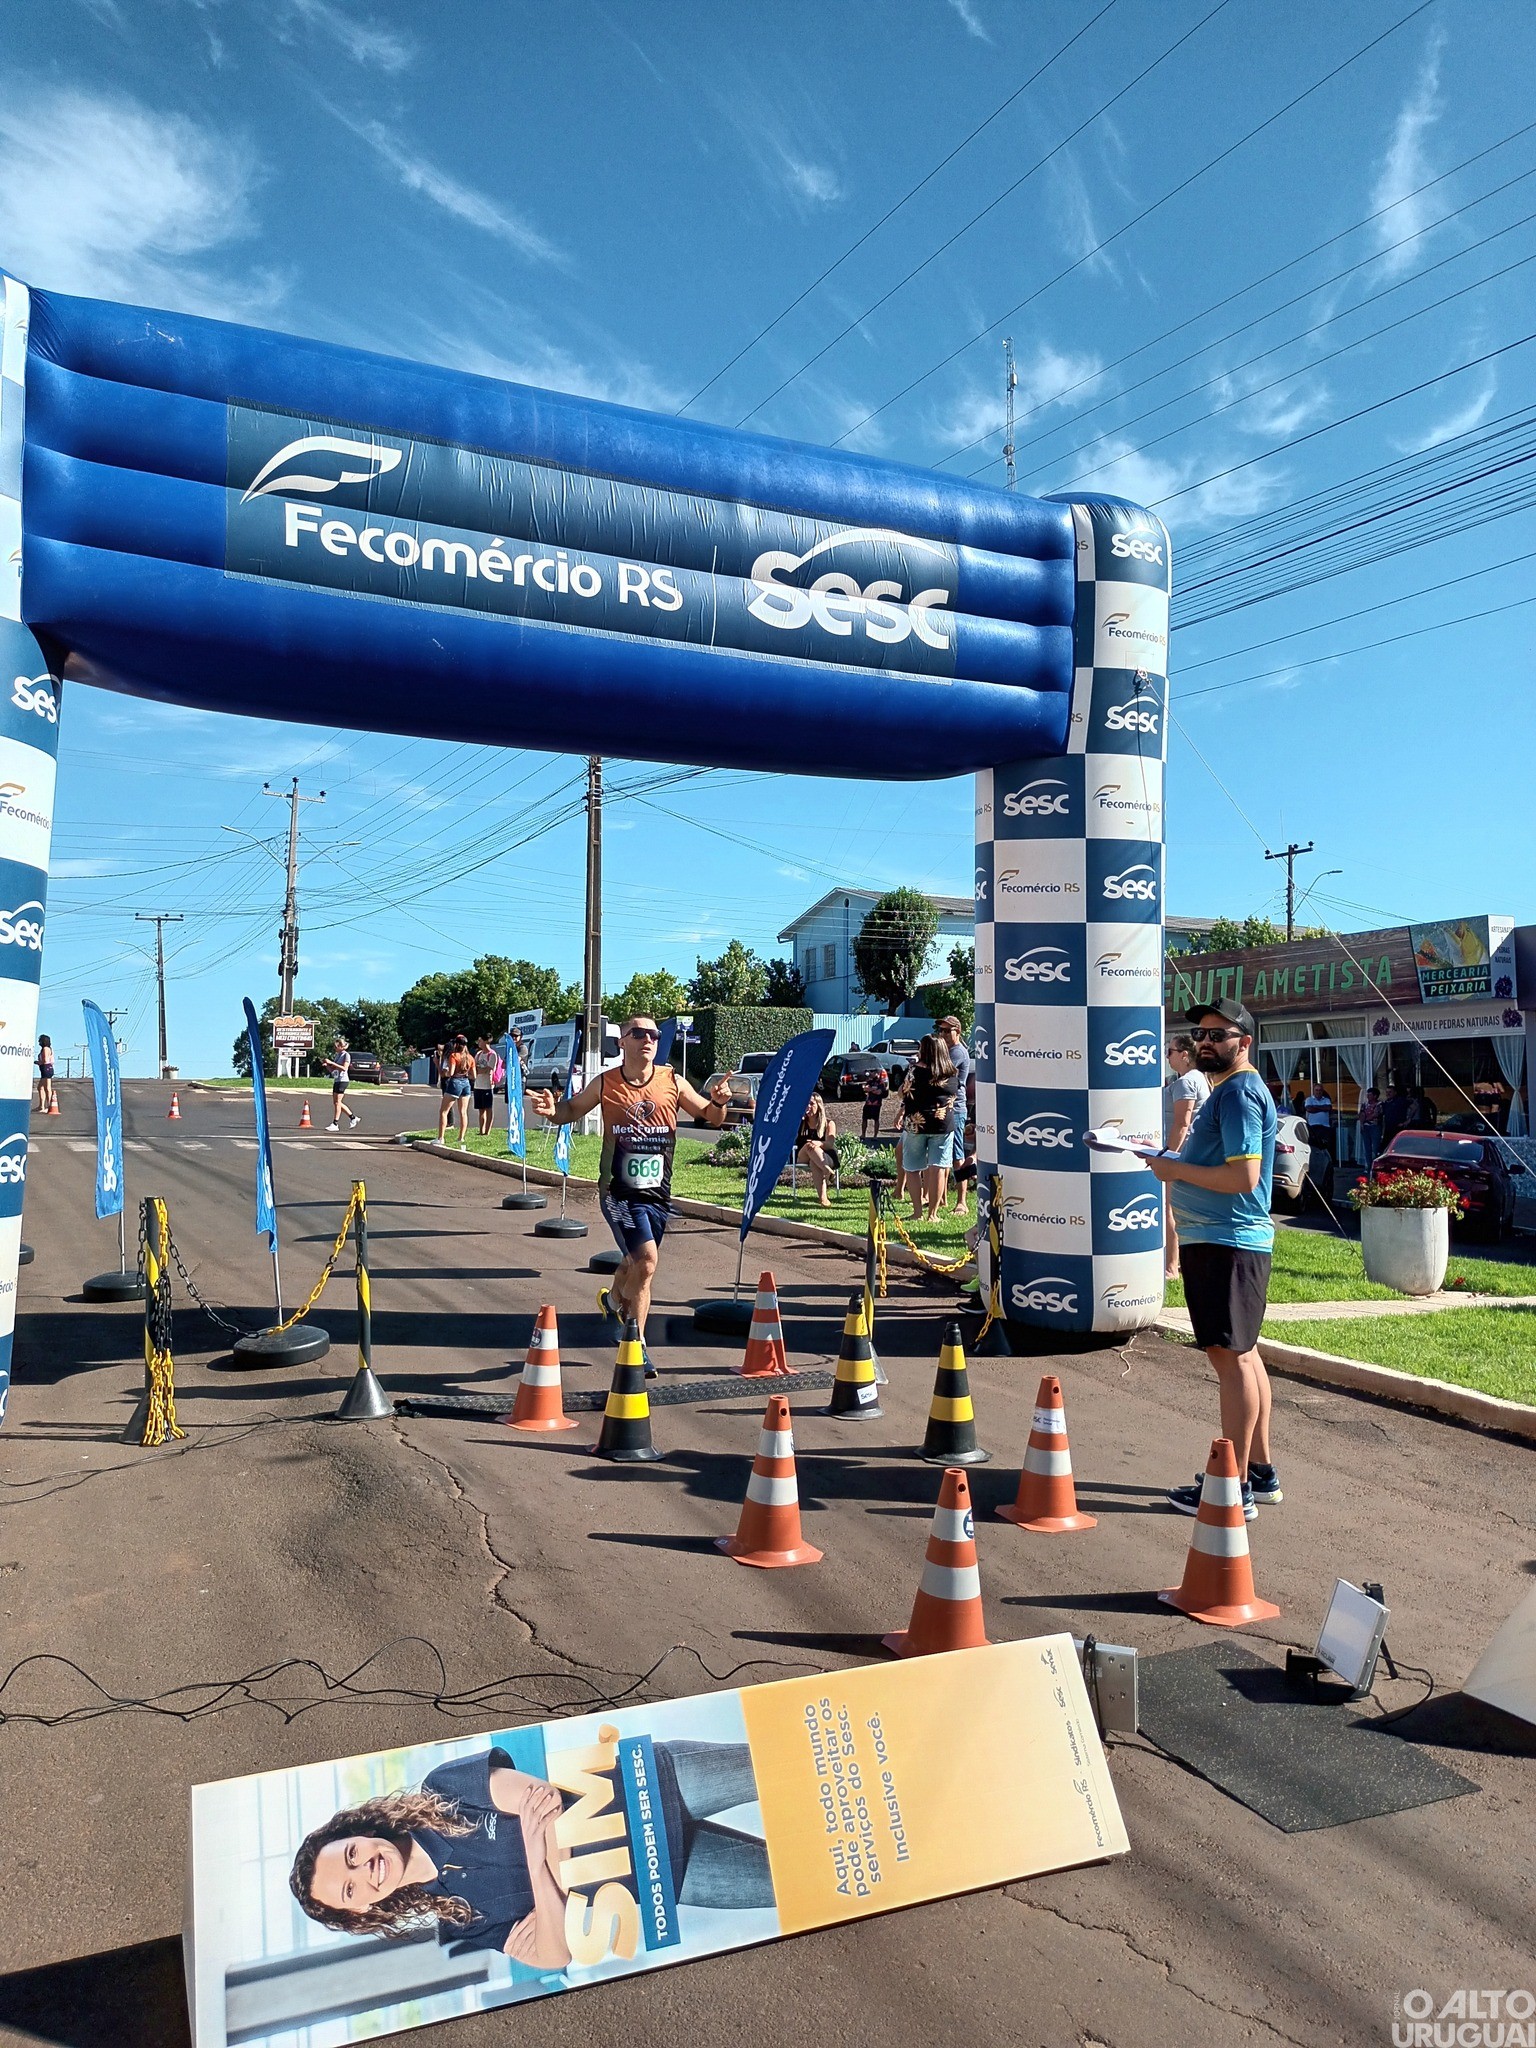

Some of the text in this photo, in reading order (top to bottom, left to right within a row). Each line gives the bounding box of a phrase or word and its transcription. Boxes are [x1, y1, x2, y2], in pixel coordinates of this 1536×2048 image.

[284, 502, 684, 612] Fecomércio RS
[1110, 525, 1164, 567] Sesc
[747, 528, 950, 651] Sesc
[1108, 627, 1158, 643] Fecomércio
[1104, 696, 1159, 735] Sesc
[1002, 779, 1070, 817] Sesc
[1099, 798, 1152, 812] Fecomércio
[1001, 882, 1081, 894] Fecomércio RS
[1102, 864, 1156, 901] Sesc
[1003, 947, 1071, 983] Sesc
[1100, 965, 1152, 978] Fecomércio
[1253, 956, 1392, 997] AMETISTA
[1422, 965, 1489, 982] MERCEARIA
[1430, 980, 1486, 995] PEIXARIA
[1392, 1015, 1500, 1032] ARTESANATO E PEDRAS NATURAIS
[1002, 1046, 1082, 1061] Fecomércio RS
[1103, 1029, 1157, 1066] Sesc
[763, 1049, 794, 1122] Fecomércio
[772, 1083, 792, 1124] Senac
[637, 1124, 670, 1134] Forma
[1006, 1112, 1074, 1149] Sesc
[627, 1158, 660, 1178] 669
[1006, 1208, 1086, 1226] Fecomércio RS
[1107, 1193, 1160, 1232] Sesc
[1011, 1276, 1078, 1314] Sesc
[1107, 1295, 1156, 1309] Fecomércio
[1066, 1720, 1083, 1767] Sindicatos
[804, 1704, 852, 1896] Aqui, todo mundo
[819, 1697, 871, 1897] pode aproveitar os
[837, 1704, 882, 1883] serviços do Sesc.
[866, 1711, 910, 1862] Inclusive você.
[1080, 1778, 1089, 1793] RS
[1086, 1794, 1105, 1848] Fecomércio
[631, 1743, 668, 1940] TODOS PODEM SER SESC.
